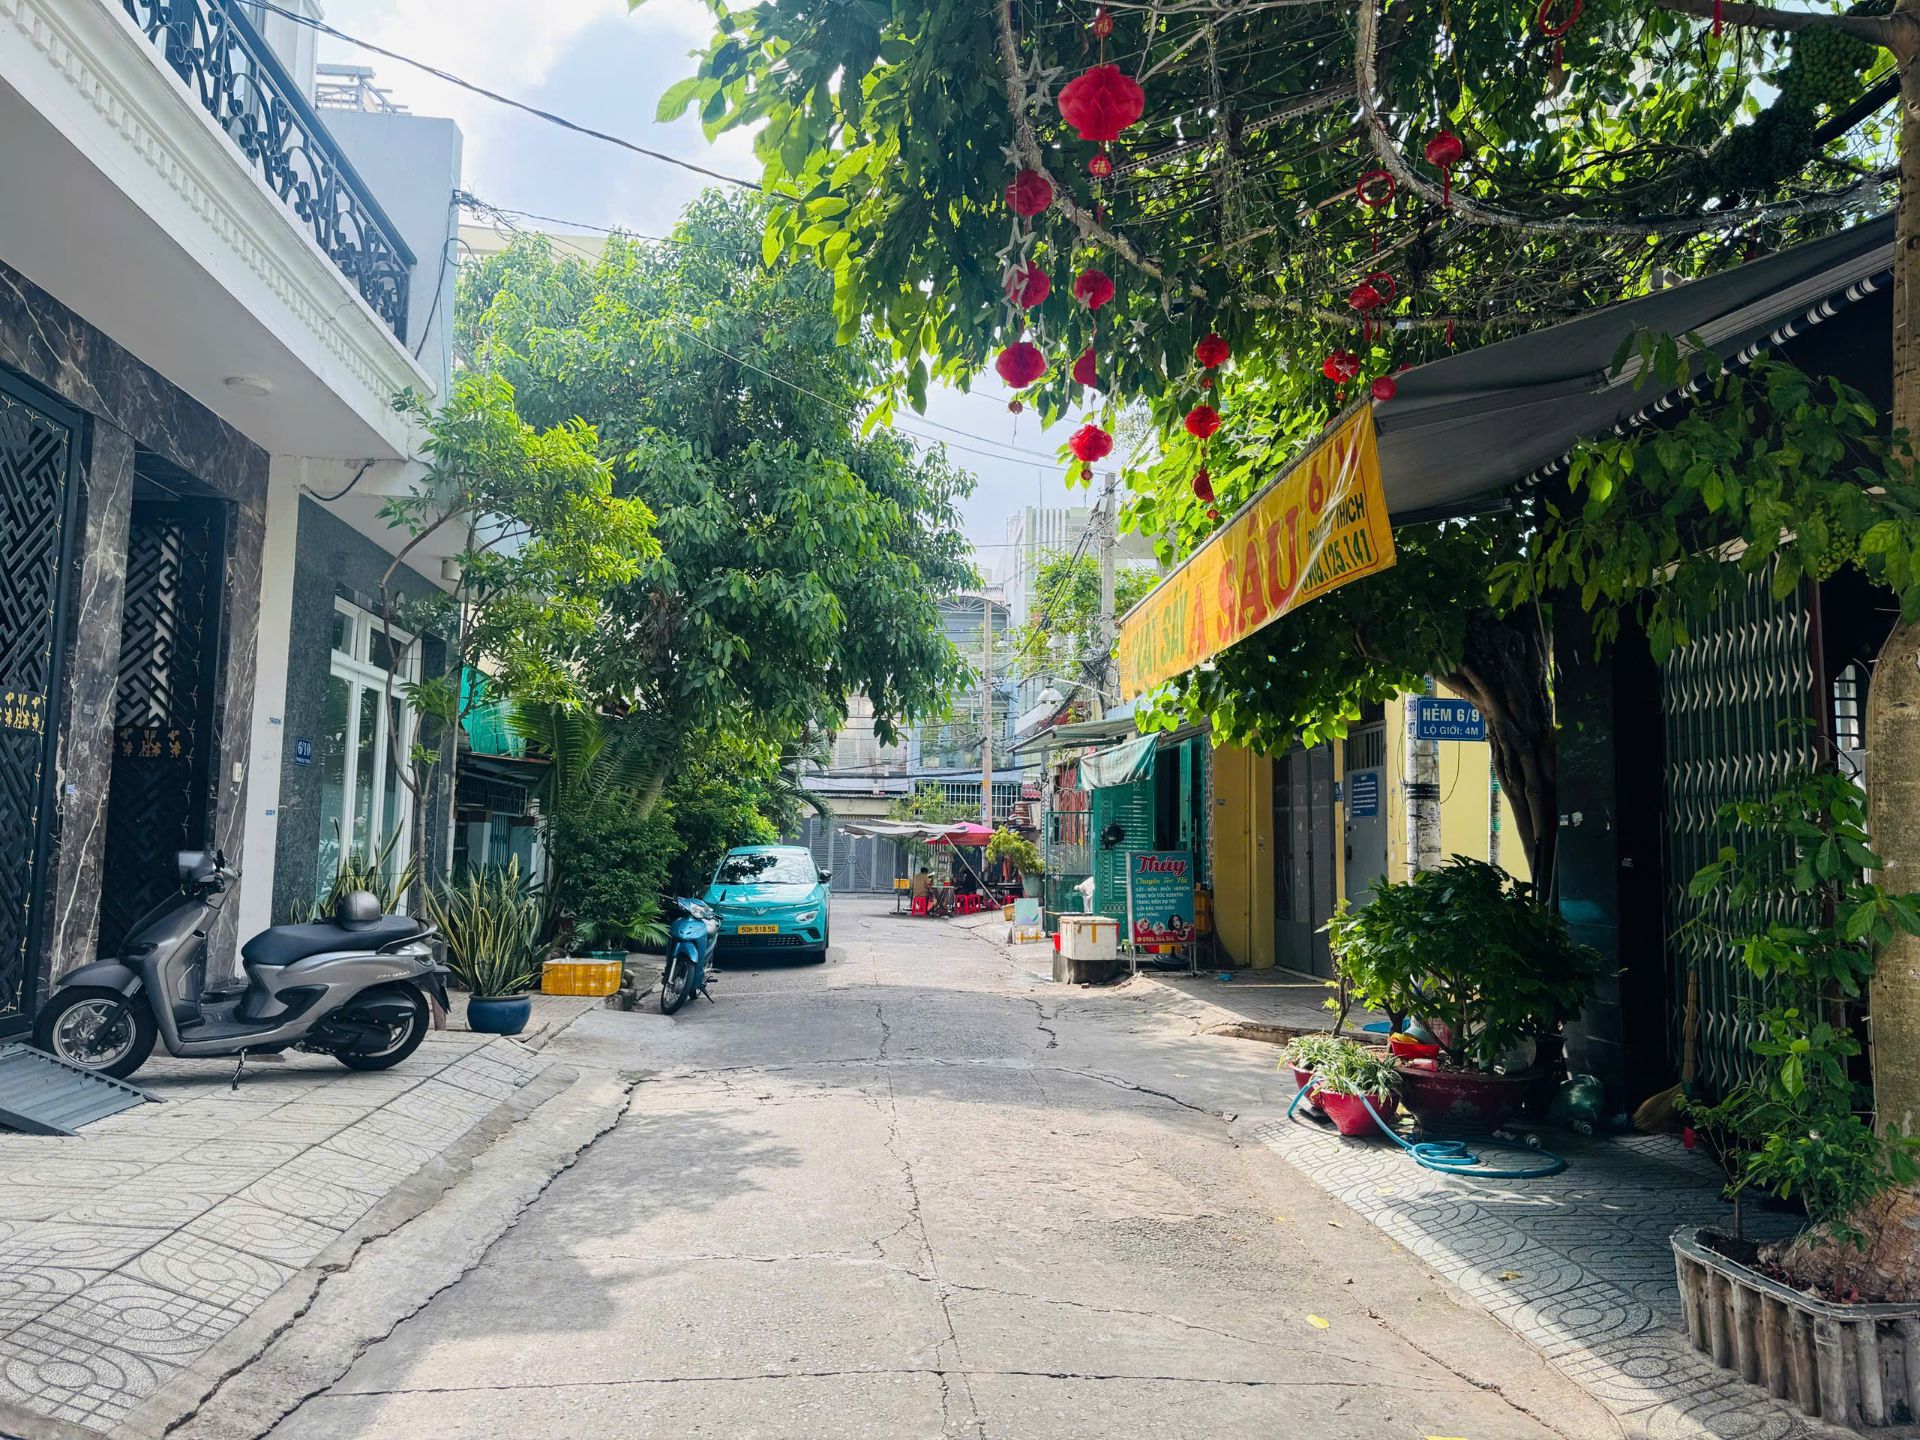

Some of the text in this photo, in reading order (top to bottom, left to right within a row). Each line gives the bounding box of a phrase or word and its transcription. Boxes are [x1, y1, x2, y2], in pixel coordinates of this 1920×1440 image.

[1216, 505, 1299, 643] SÁU
[1422, 703, 1452, 721] HẺM
[1456, 708, 1480, 724] 6/9
[1424, 724, 1437, 736] LỘ
[1439, 724, 1463, 735] GIỚI:
[1465, 726, 1479, 736] 4M
[297, 740, 311, 757] 6/10
